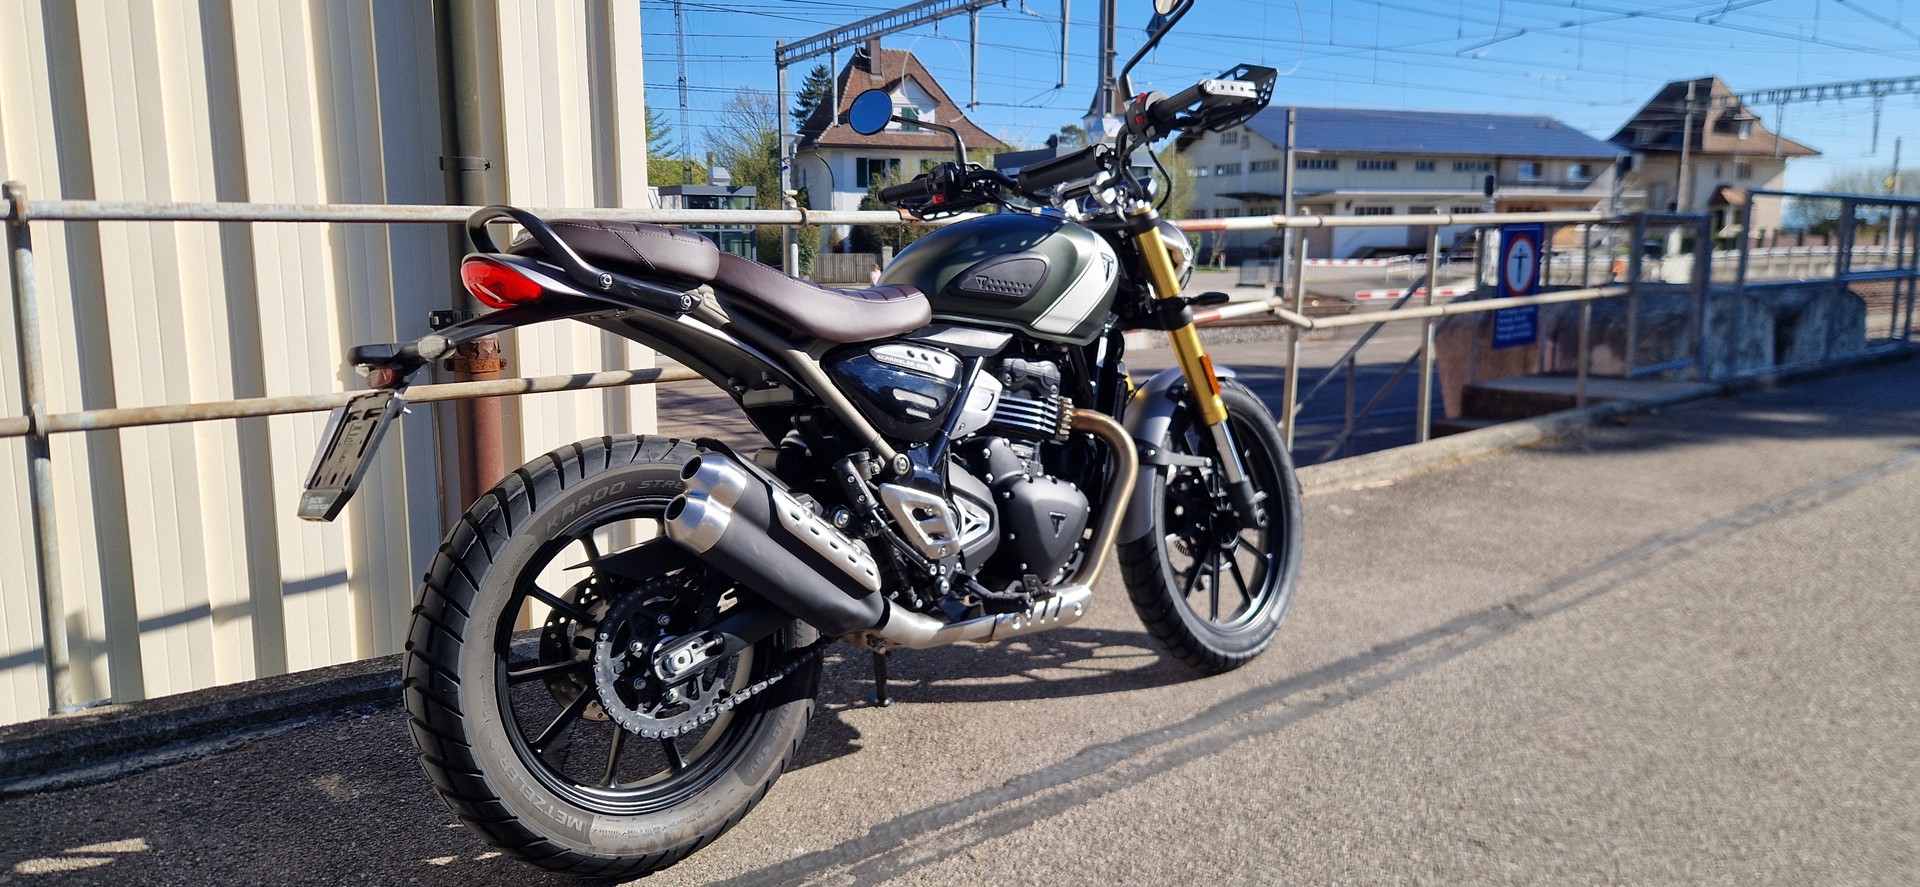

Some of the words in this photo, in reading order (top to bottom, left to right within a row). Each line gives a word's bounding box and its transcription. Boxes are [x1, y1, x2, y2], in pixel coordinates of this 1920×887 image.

[876, 354, 915, 367] SCRAMBLER
[545, 480, 626, 534] KAROO
[497, 754, 584, 832] METZELER
